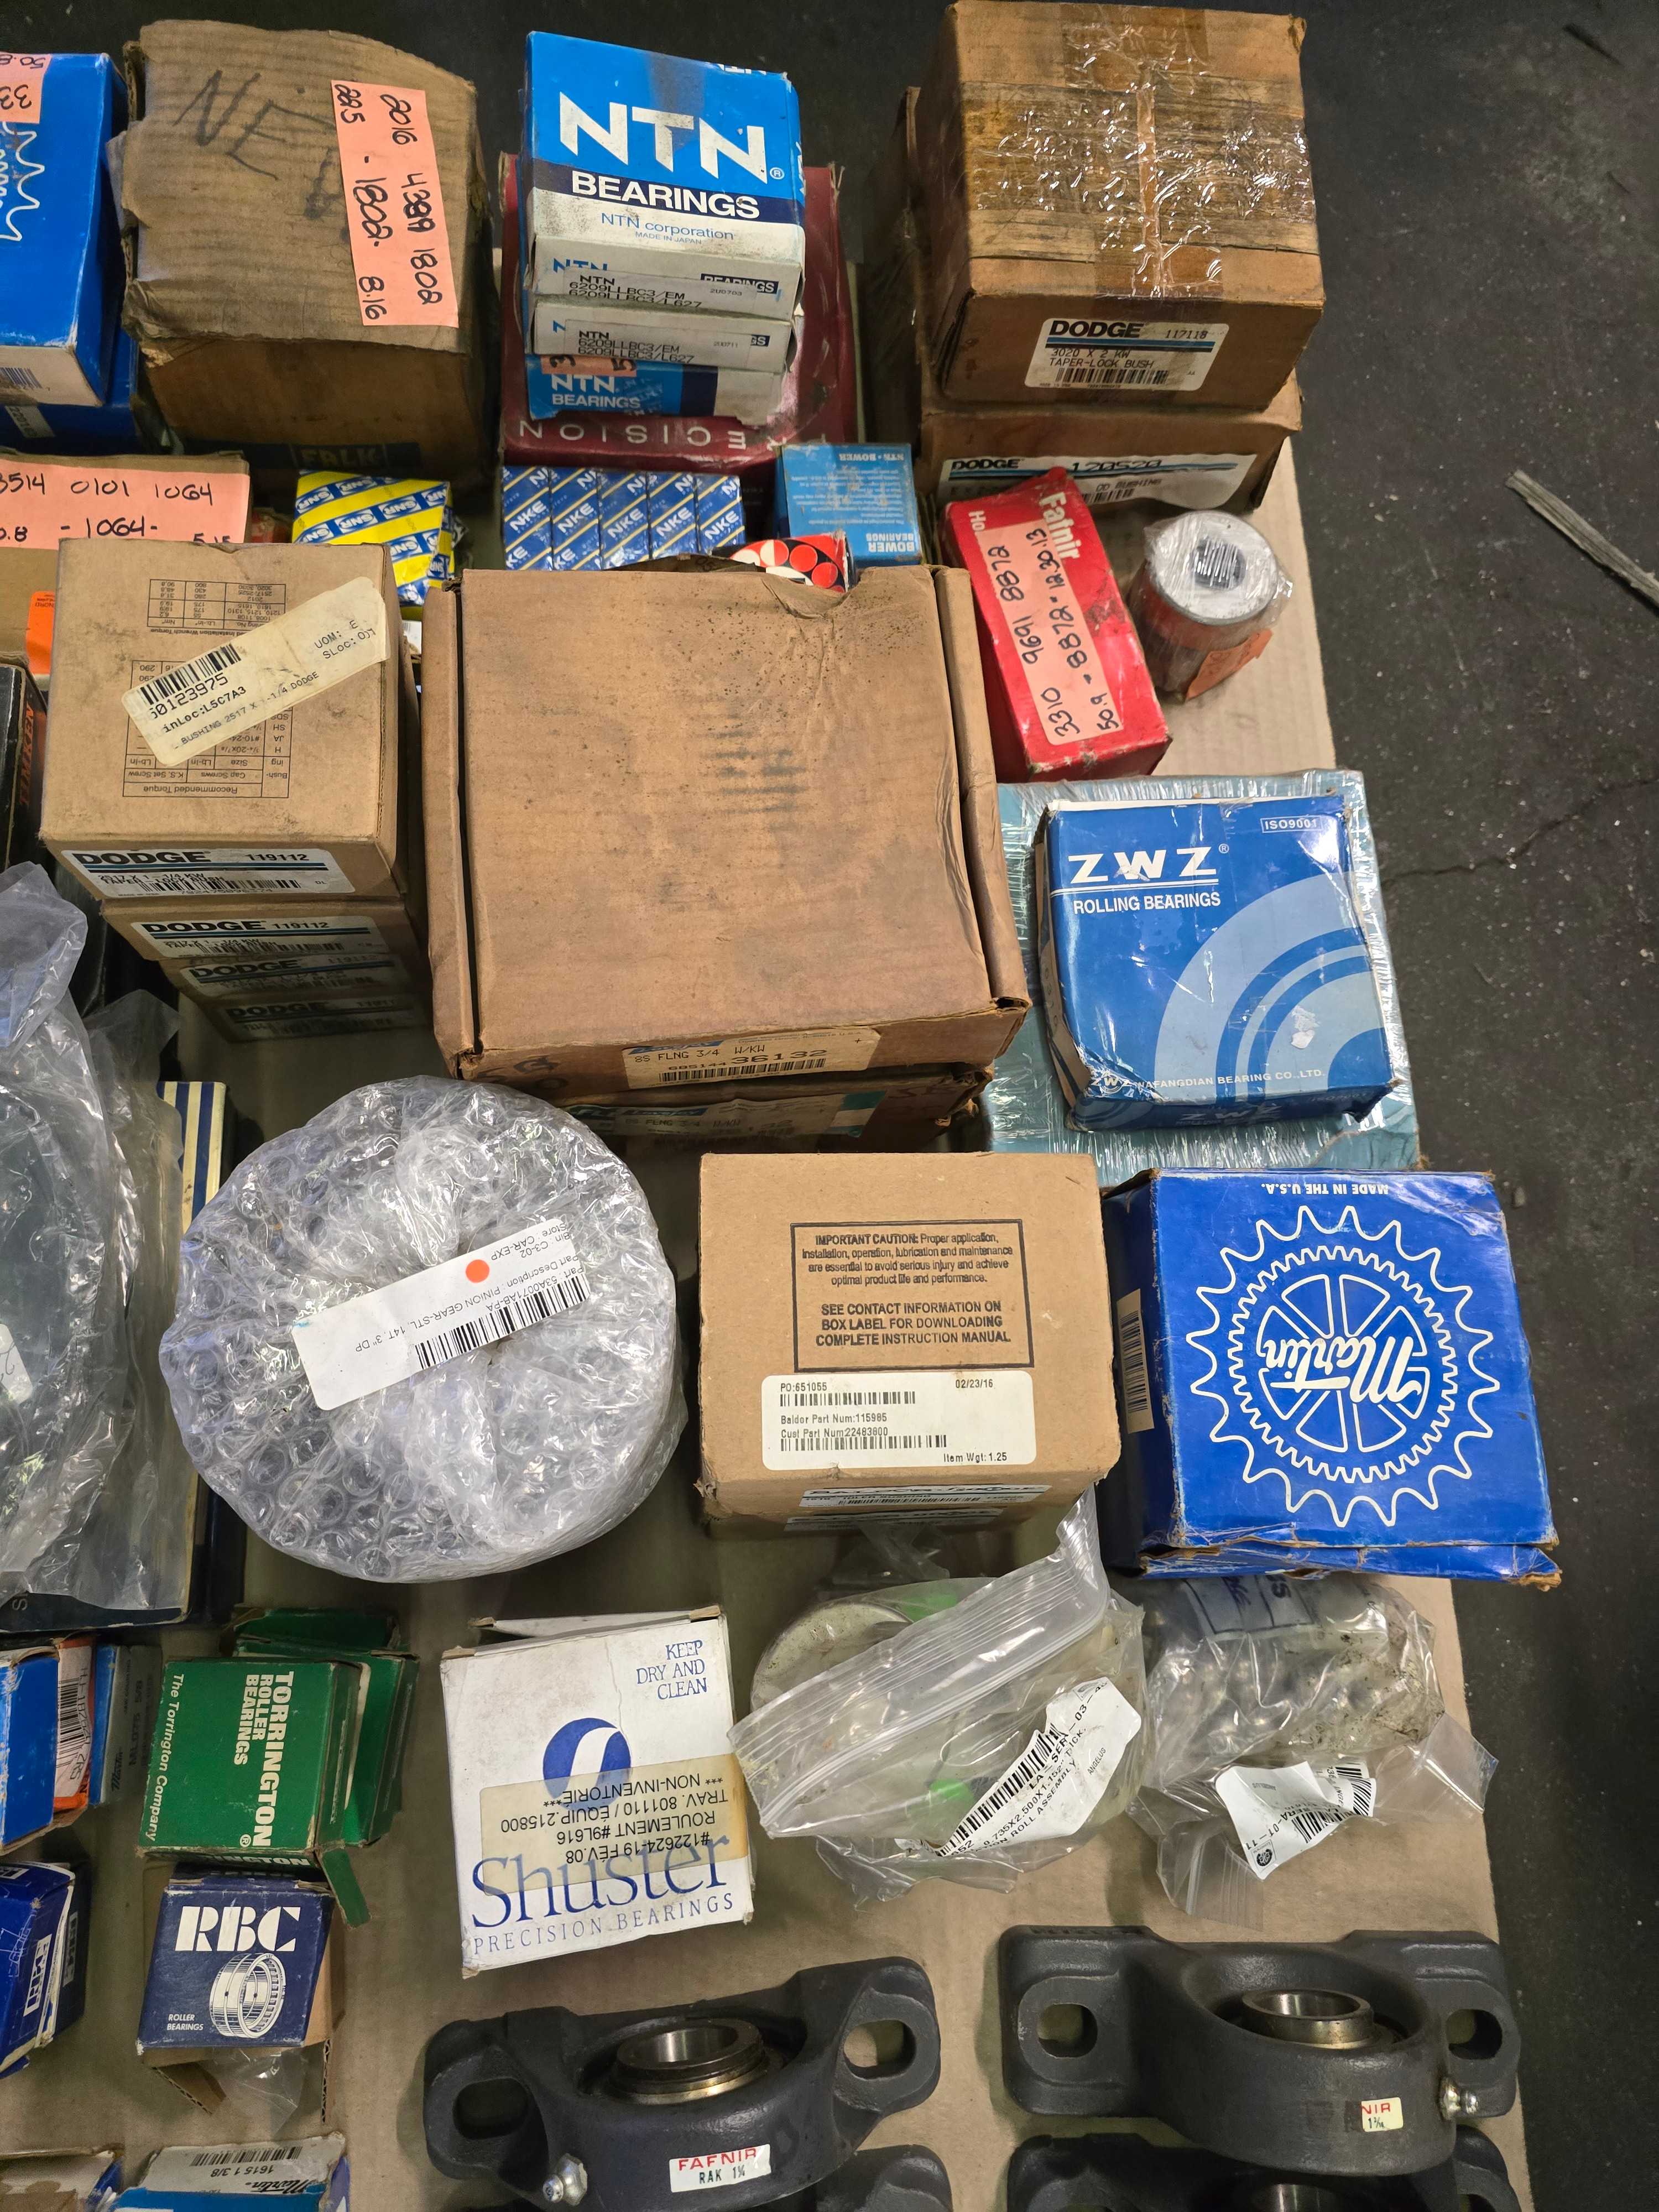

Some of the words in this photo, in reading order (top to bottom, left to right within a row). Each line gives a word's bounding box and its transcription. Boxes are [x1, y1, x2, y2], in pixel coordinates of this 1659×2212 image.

[559, 91, 768, 184] NTN
[379, 93, 418, 145] 2016
[410, 248, 443, 305] 1802
[571, 170, 760, 219] BEARINGS
[600, 212, 640, 229] NTN
[644, 221, 735, 241] corporation
[634, 230, 662, 241] MADE
[664, 233, 672, 242] IN
[674, 234, 703, 246] JAPAN
[580, 274, 615, 286] NTN
[358, 275, 388, 321] 8.16
[1048, 320, 1145, 338] DODGE
[1165, 329, 1208, 340] 117118
[1051, 348, 1080, 357] 3020
[1100, 349, 1108, 358] 2
[1114, 349, 1131, 359] KW
[1049, 358, 1118, 368] TAPER-LOCK
[1124, 359, 1155, 369] BUSH
[552, 374, 616, 394] NTN
[552, 394, 641, 409] BEARINGS
[950, 458, 1021, 470] DODGE
[71, 477, 129, 497] 0101
[154, 482, 213, 506] 1064
[383, 499, 418, 515] SNR
[510, 500, 546, 531] NKE
[86, 515, 145, 539] 1064
[339, 513, 375, 529] SNR
[557, 503, 594, 533] NKE
[607, 508, 644, 539] NKE
[656, 507, 693, 537] NKE
[705, 510, 739, 540] NKE
[865, 532, 914, 541] BEARINGS
[868, 541, 915, 553] BOWER
[987, 545, 1025, 603] 8872
[313, 630, 343, 651] UOM:
[1013, 614, 1045, 666] 9691
[1048, 604, 1088, 669] 8872
[321, 638, 357, 661] SLoc:
[180, 720, 223, 745] BUSHING
[219, 708, 247, 727] 2517
[289, 671, 320, 691] DODGE
[1040, 686, 1082, 738] 3310
[271, 758, 284, 766] ing
[143, 785, 172, 794] Torque
[174, 786, 238, 795] Recommended
[1264, 818, 1318, 831] ISO9001
[73, 851, 211, 865] DODGE
[244, 853, 310, 862] 119112
[1073, 894, 1140, 915] ROLLING
[1144, 891, 1222, 911] BEARINGS
[140, 921, 266, 932] DODGE
[272, 921, 330, 930] 119112
[189, 959, 301, 977] DODGE
[658, 1052, 689, 1061] FLNG
[696, 1049, 720, 1058] 3/4
[734, 1045, 766, 1055] W/KW
[730, 1050, 828, 1065] 36132
[1216, 1072, 1272, 1085] BEARING
[1261, 1183, 1301, 1195] U.S.A.
[1305, 1183, 1329, 1194] THE
[1333, 1183, 1347, 1194] IN
[1351, 1183, 1389, 1194] MADE
[541, 1222, 568, 1240] Store
[555, 1231, 571, 1244] Bin
[815, 1234, 871, 1245] IMPORTANT
[872, 1233, 919, 1244] CAUTION:
[920, 1233, 949, 1246] Proper
[951, 1232, 999, 1245] application,
[489, 1234, 535, 1261] CAR-EXP
[519, 1239, 549, 1259] C3-02
[852, 1247, 894, 1259] operation,
[896, 1246, 939, 1258] lubrication
[940, 1246, 957, 1256] and
[958, 1246, 1013, 1256] maintenance
[506, 1260, 558, 1288] Description
[808, 1264, 823, 1272] are
[825, 1261, 863, 1272] essential
[864, 1261, 873, 1271] to
[874, 1260, 898, 1271] avoid
[899, 1260, 931, 1270] serious
[932, 1260, 955, 1272] injury
[957, 1260, 973, 1270] and
[975, 1259, 1009, 1269] achieve
[831, 1274, 863, 1286] optimal
[864, 1274, 897, 1286] product
[912, 1273, 929, 1284] and
[931, 1272, 988, 1286] performance.
[465, 1285, 502, 1306] PINION
[486, 1275, 558, 1312] 53A0071AB-PA
[821, 1303, 844, 1316] SEE
[847, 1302, 901, 1315] CONTACT
[904, 1301, 982, 1313] INFORMATION
[984, 1300, 1001, 1312] ON
[821, 1318, 847, 1331] BOX
[849, 1318, 886, 1330] LABEL
[889, 1317, 913, 1329] FOR
[916, 1315, 1003, 1328] DOWNLOADING
[355, 1338, 372, 1353] DP
[816, 1333, 879, 1346] COMPLETE
[882, 1331, 959, 1344] INSTRUCTION
[961, 1330, 1011, 1343] MANUAL
[1265, 1335, 1423, 1405] Martin
[780, 1382, 827, 1392] PO:651055
[955, 1378, 994, 1389] 02/23/16
[781, 1413, 808, 1425] Baldor
[811, 1413, 830, 1424] Part
[832, 1412, 888, 1423] Num:115985
[781, 1428, 800, 1438] Cust
[803, 1428, 820, 1438] Part
[943, 1453, 963, 1463] Item
[966, 1452, 987, 1464] Wgt:
[988, 1452, 1008, 1462] 1.25
[665, 1639, 703, 1661] KEEP
[636, 1665, 667, 1686] DRY
[672, 1659, 706, 1678] AND
[170, 1673, 185, 1698] The
[657, 1677, 708, 1700] CLEAN
[251, 1674, 274, 1741] ROLLER
[233, 1673, 260, 1766] BEARINGS
[160, 1701, 180, 1771] Torrington
[252, 1671, 294, 1847] TORRINGTON
[1087, 1747, 1107, 1776] ANGELUS
[623, 1796, 677, 1815] 801110
[686, 1787, 729, 1808] TRAV.
[1010, 1815, 1037, 1838] ROLL
[1036, 1759, 1078, 1815] ASSEMBLY
[148, 1774, 169, 1842] Company
[613, 1810, 716, 1838] ROULEMENT
[556, 1826, 611, 1845] #9L616
[623, 1833, 711, 1855] #122624-19
[565, 1846, 619, 1865] FÉV.08
[471, 1834, 731, 1928] Shuster
[174, 1906, 301, 1952] RBC
[473, 1916, 602, 1955] PRECISION
[617, 1892, 733, 1931] BEARINGS
[168, 2012, 196, 2022] ROLLER
[166, 2022, 204, 2032] BEARINGS
[677, 2147, 757, 2171] FAFNIR
[210, 2168, 231, 2178] 3/8
[245, 2164, 274, 2174] 1615
[698, 2168, 723, 2184] RAK
[249, 2179, 309, 2195] Martin
